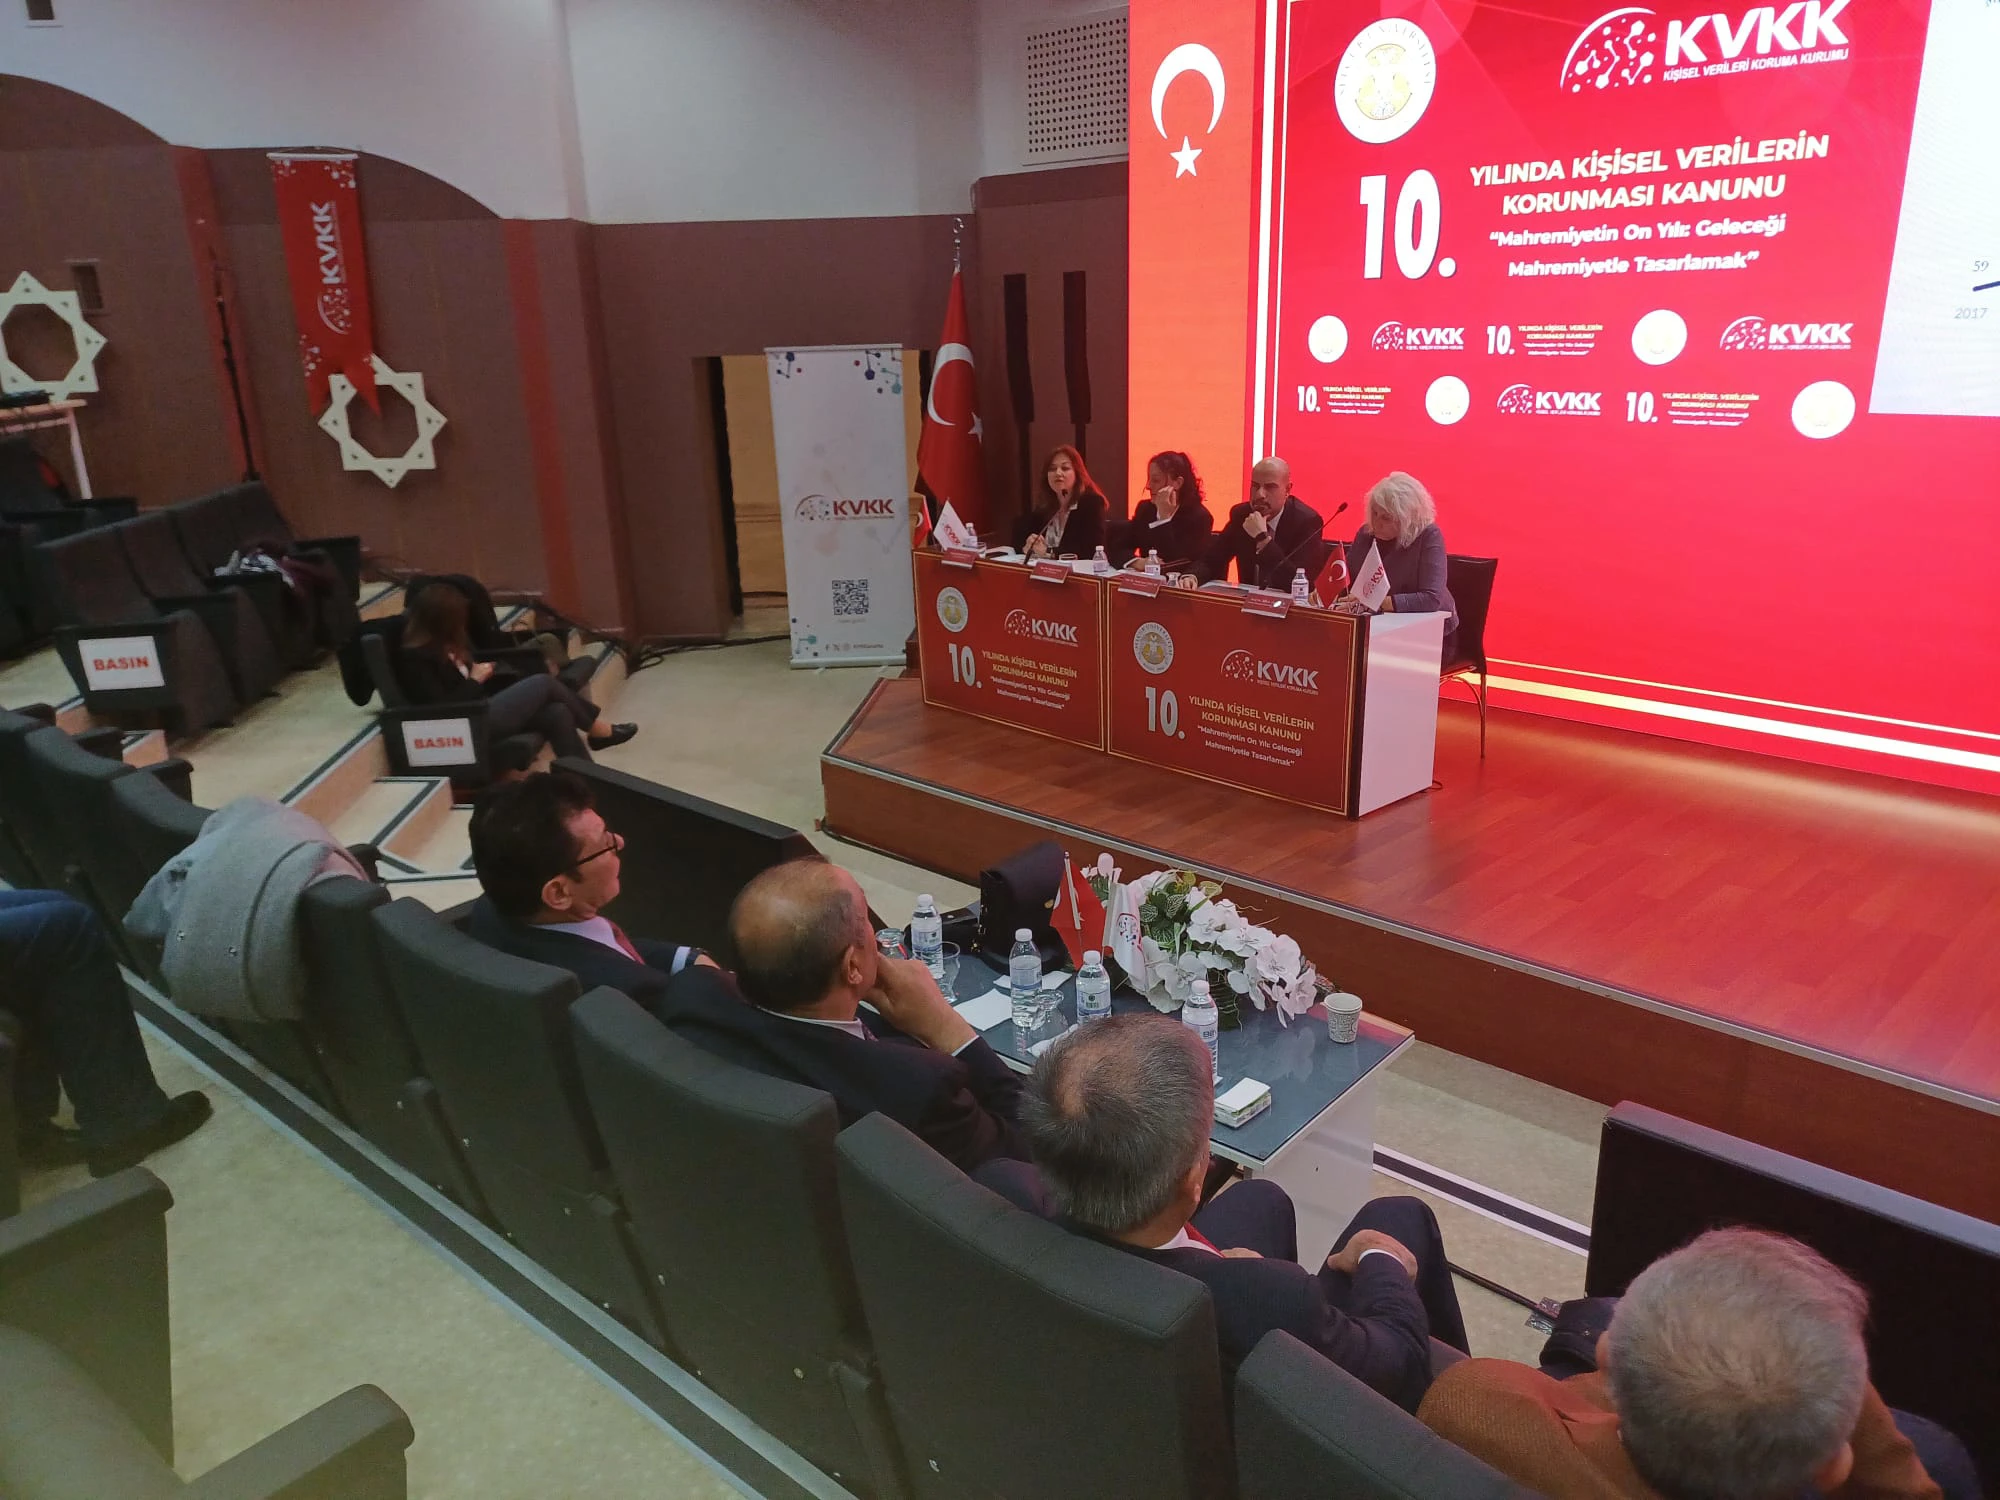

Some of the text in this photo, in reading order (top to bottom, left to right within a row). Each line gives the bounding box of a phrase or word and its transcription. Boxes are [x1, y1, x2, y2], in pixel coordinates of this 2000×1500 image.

[1664, 0, 1851, 66] KVKK
[1663, 48, 1849, 82] KİŞİSEL VERİLERİ KORUMA KURUMU
[1470, 130, 1830, 187] YILINDA KİŞİSEL VERİLERİN
[1502, 174, 1787, 216] KORUNMASI KANUNU
[1359, 169, 1456, 280] 10.
[1624, 224, 1651, 240] On
[1695, 213, 1787, 238] Geleceği
[310, 202, 341, 285] KVKK
[1508, 258, 1629, 280] Mahremiyetle
[1972, 260, 1990, 273] 59
[1953, 306, 1989, 320] 2017
[1406, 326, 1465, 346] KVKK
[1487, 325, 1515, 355] 10.
[1769, 323, 1853, 344] KVKK
[1297, 385, 1321, 412] 10.
[1536, 392, 1602, 410] KVKK
[1626, 391, 1658, 423] 10.
[833, 500, 895, 516] KVKK
[1031, 618, 1078, 643] KVKK
[93, 655, 149, 671] BASIN
[948, 643, 982, 689] 10.
[982, 650, 1078, 679] YILINDA KİŞİSEL VERİLERİN
[992, 663, 1069, 688] KORUNMASI KANUNU
[1257, 660, 1319, 690] KVKK
[1145, 686, 1186, 740] 10.
[1189, 695, 1315, 731] YILINDA KİŞİSEL VERİLERİN
[1202, 711, 1302, 742] KORUNMASI KANUNU
[414, 736, 463, 750] BASIN
[1247, 735, 1257, 745] On
